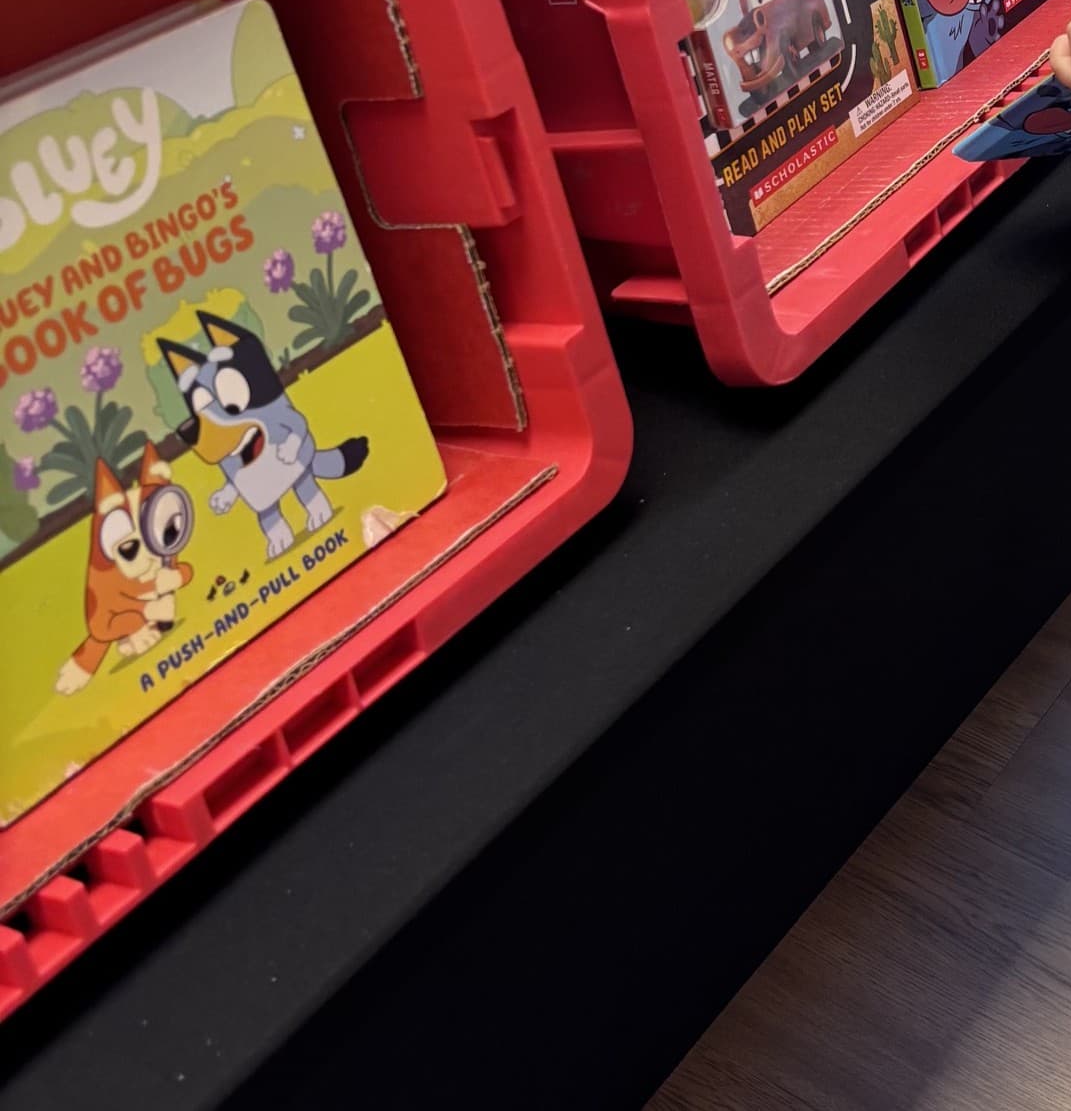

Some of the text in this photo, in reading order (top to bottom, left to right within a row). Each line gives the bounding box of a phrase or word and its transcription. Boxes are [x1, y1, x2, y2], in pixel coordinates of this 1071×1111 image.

[703, 61, 721, 96] MATER
[722, 82, 843, 187] READ AND PLAY SET
[763, 131, 837, 193] SCHOLASTIC
[0, 182, 238, 329] UEY AND BINGO'S
[0, 214, 255, 388] OOK OF BUGS
[140, 528, 349, 692] A PUSH-AND-PULL BOOK
